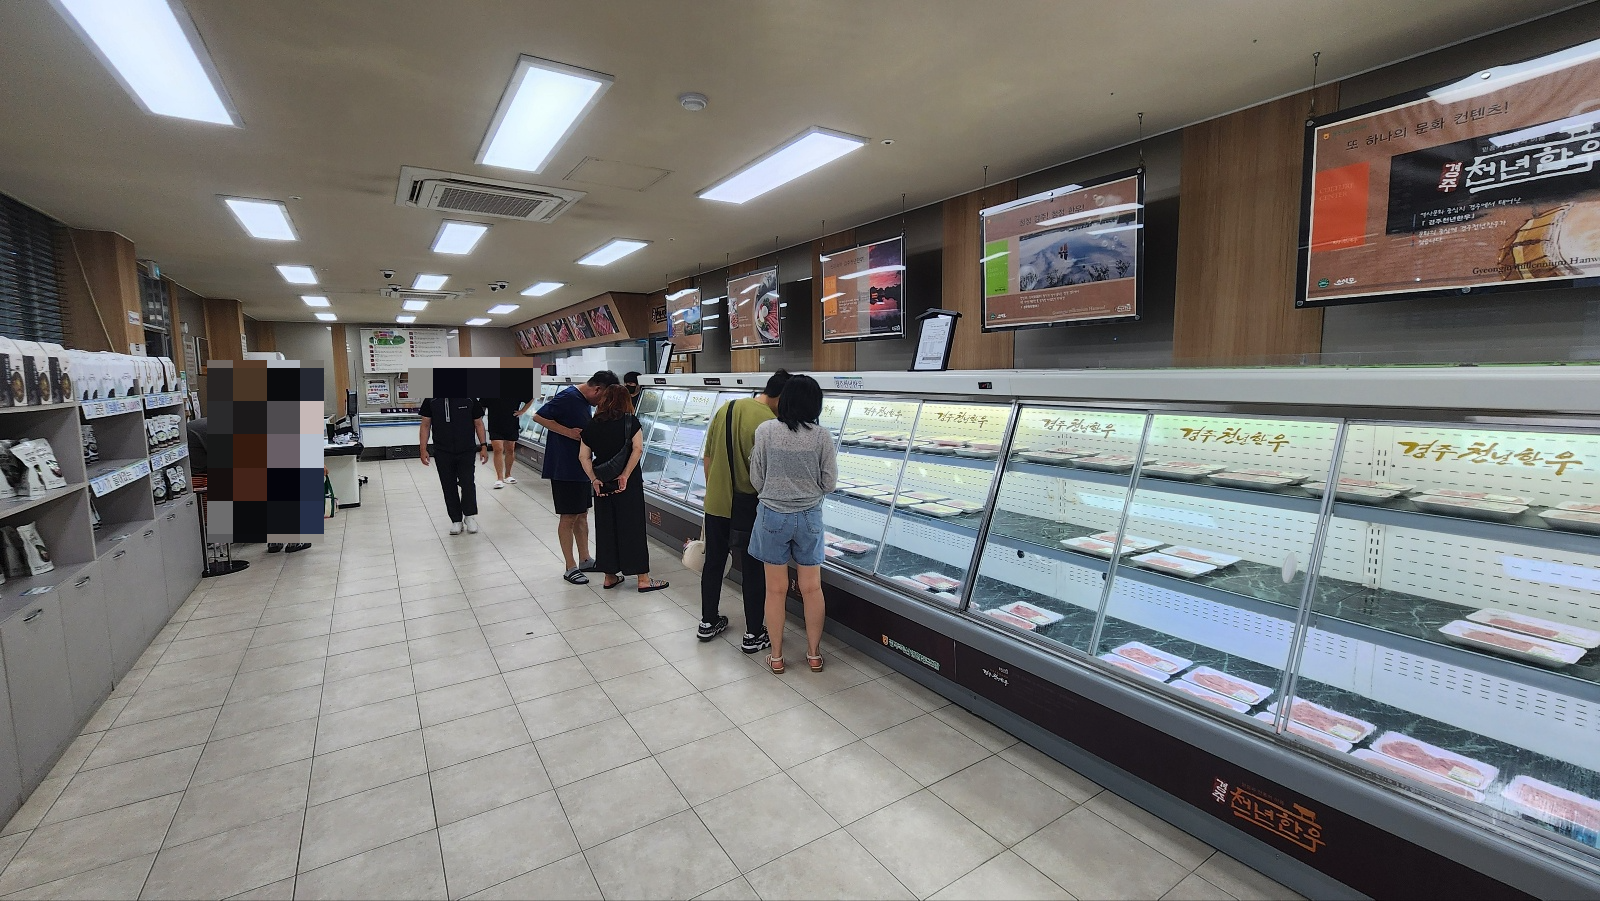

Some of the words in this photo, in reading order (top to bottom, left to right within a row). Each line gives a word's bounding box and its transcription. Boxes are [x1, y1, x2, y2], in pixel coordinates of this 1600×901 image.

[1345, 140, 1359, 151] 또
[1365, 126, 1408, 145] 하나의
[1414, 117, 1446, 135] 문화
[1453, 101, 1510, 124] 컨텐츠!
[1438, 162, 1463, 193] 경주
[1319, 191, 1348, 201] CENTER
[1472, 264, 1512, 276] Gyeongju
[1514, 259, 1568, 271] millennium
[1569, 256, 1600, 265] Hanw
[1211, 778, 1229, 803] 경주
[1230, 786, 1326, 853] 천년한우
